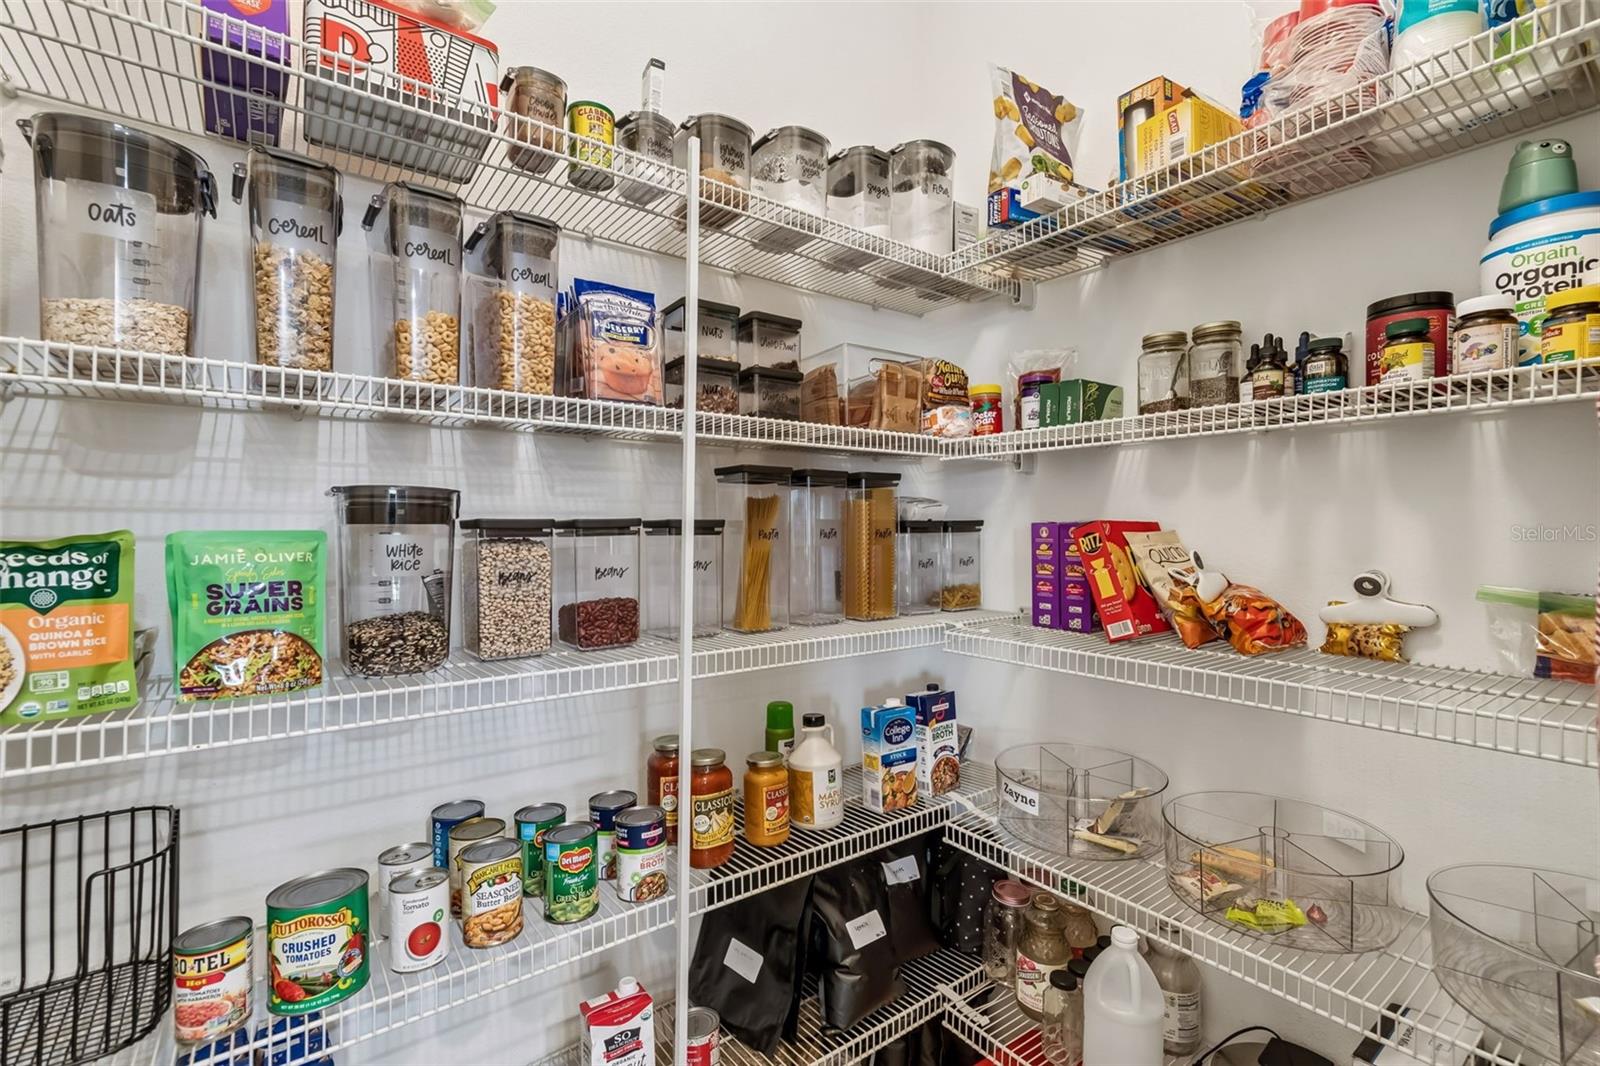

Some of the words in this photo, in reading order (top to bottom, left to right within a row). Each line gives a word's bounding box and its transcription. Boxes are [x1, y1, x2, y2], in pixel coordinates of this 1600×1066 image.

[587, 114, 605, 125] GIRL
[1168, 111, 1179, 134] GLAD
[1511, 245, 1578, 268] Orgain
[1496, 256, 1600, 290] Organic
[973, 411, 997, 420] Peter
[1079, 533, 1103, 553] RITZ
[92, 552, 109, 565] of
[190, 551, 246, 566] JAMIE
[254, 551, 313, 563] OLIVER
[0, 560, 108, 590] hange
[206, 580, 303, 600] SUPER
[206, 597, 303, 616] GRAINS
[28, 612, 105, 630] Organic
[28, 630, 82, 643] QUINOA
[86, 629, 94, 637] &
[28, 640, 80, 652] BROWN
[83, 637, 107, 647] RICE
[31, 652, 56, 660] WITH
[58, 649, 93, 659] GARLIC
[885, 724, 911, 736] College
[932, 730, 954, 742] BROTH
[892, 735, 904, 743] Inn
[1003, 782, 1036, 807] Zayne
[695, 795, 733, 812] CLASSICO
[562, 857, 572, 865] Del
[573, 852, 591, 863] Monte
[570, 885, 584, 894] CUT
[476, 899, 501, 909] Butter
[556, 894, 578, 903] GREEN
[403, 901, 430, 911] Tomato
[275, 911, 346, 935] TUTTOROSSO
[282, 934, 336, 954] CRUSHED
[286, 947, 332, 964] TOMATOES
[185, 979, 208, 987] Hot
[614, 1031, 632, 1042] SO
